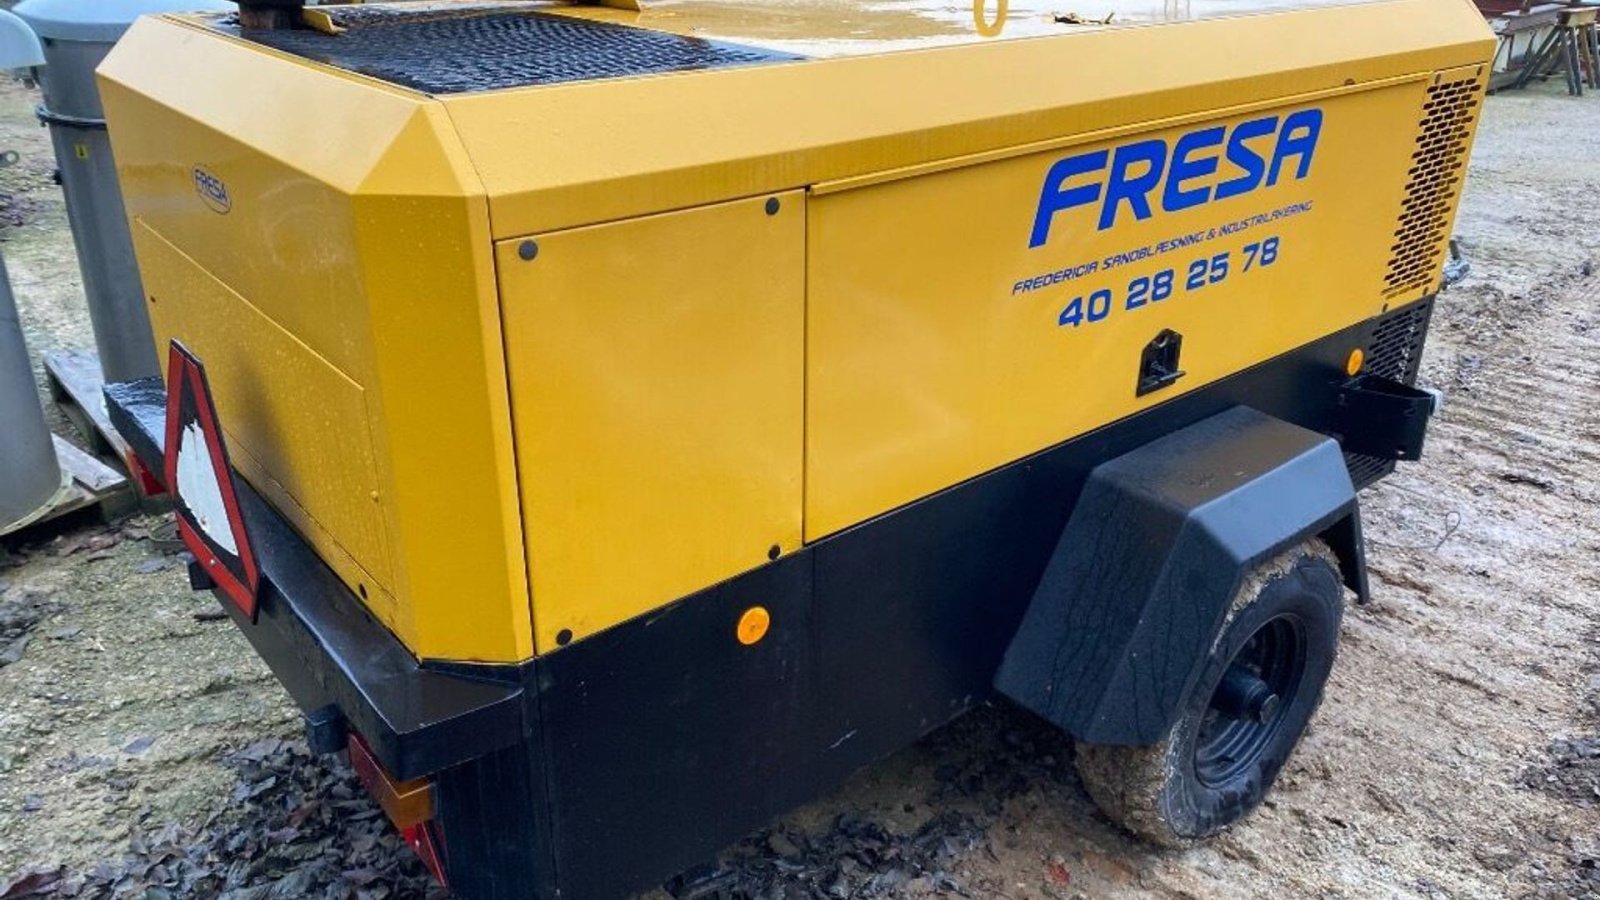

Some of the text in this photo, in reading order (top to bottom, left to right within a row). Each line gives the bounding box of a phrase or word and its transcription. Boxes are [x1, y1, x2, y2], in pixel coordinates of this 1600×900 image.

[194, 168, 228, 202] FRESA
[1028, 108, 1324, 249] FRESA
[1012, 261, 1099, 296] FREDERICIA
[1206, 228, 1217, 241] &
[1058, 236, 1281, 328] 40 28 25 78
